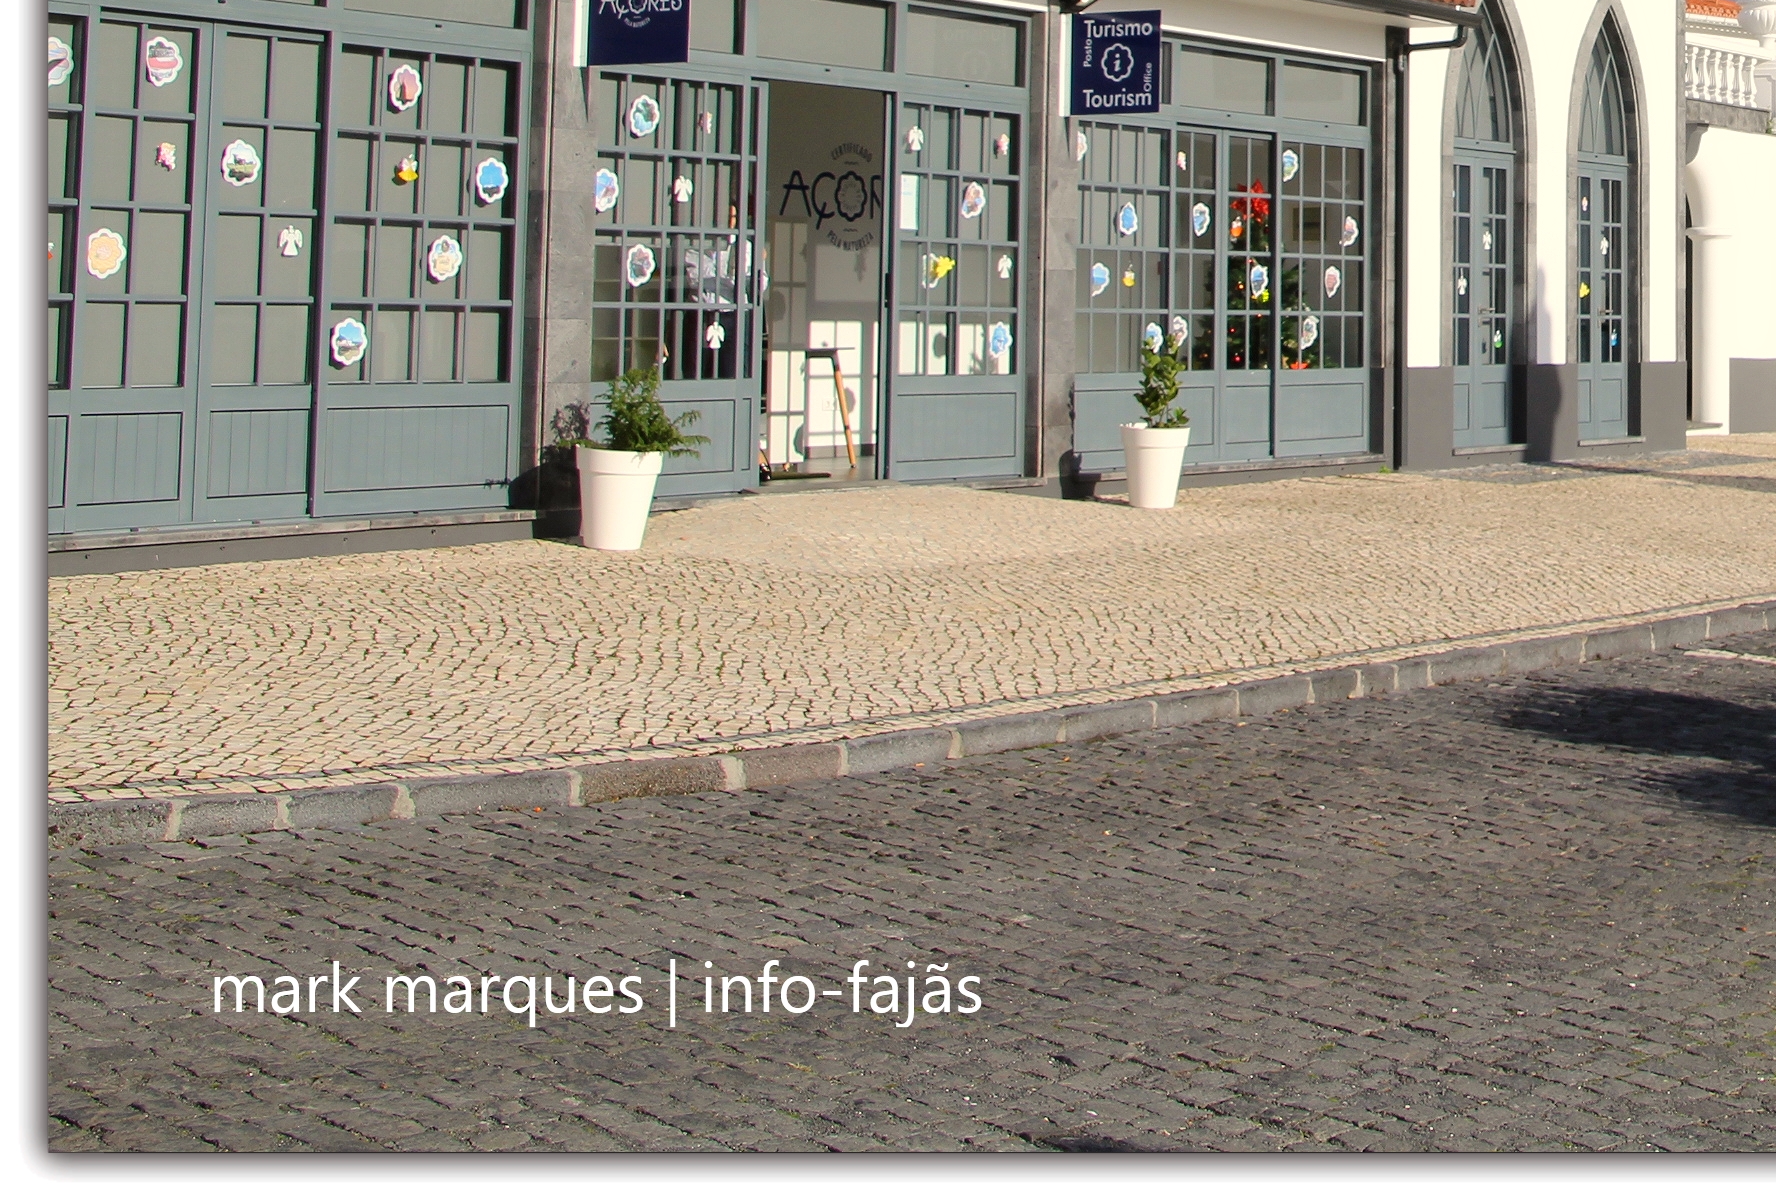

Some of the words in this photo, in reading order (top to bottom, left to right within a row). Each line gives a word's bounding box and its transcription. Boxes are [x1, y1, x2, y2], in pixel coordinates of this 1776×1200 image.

[1084, 19, 1153, 38] Turismo
[1083, 39, 1092, 67] Posto
[1143, 62, 1152, 92] Office
[1083, 88, 1152, 108] Tourism
